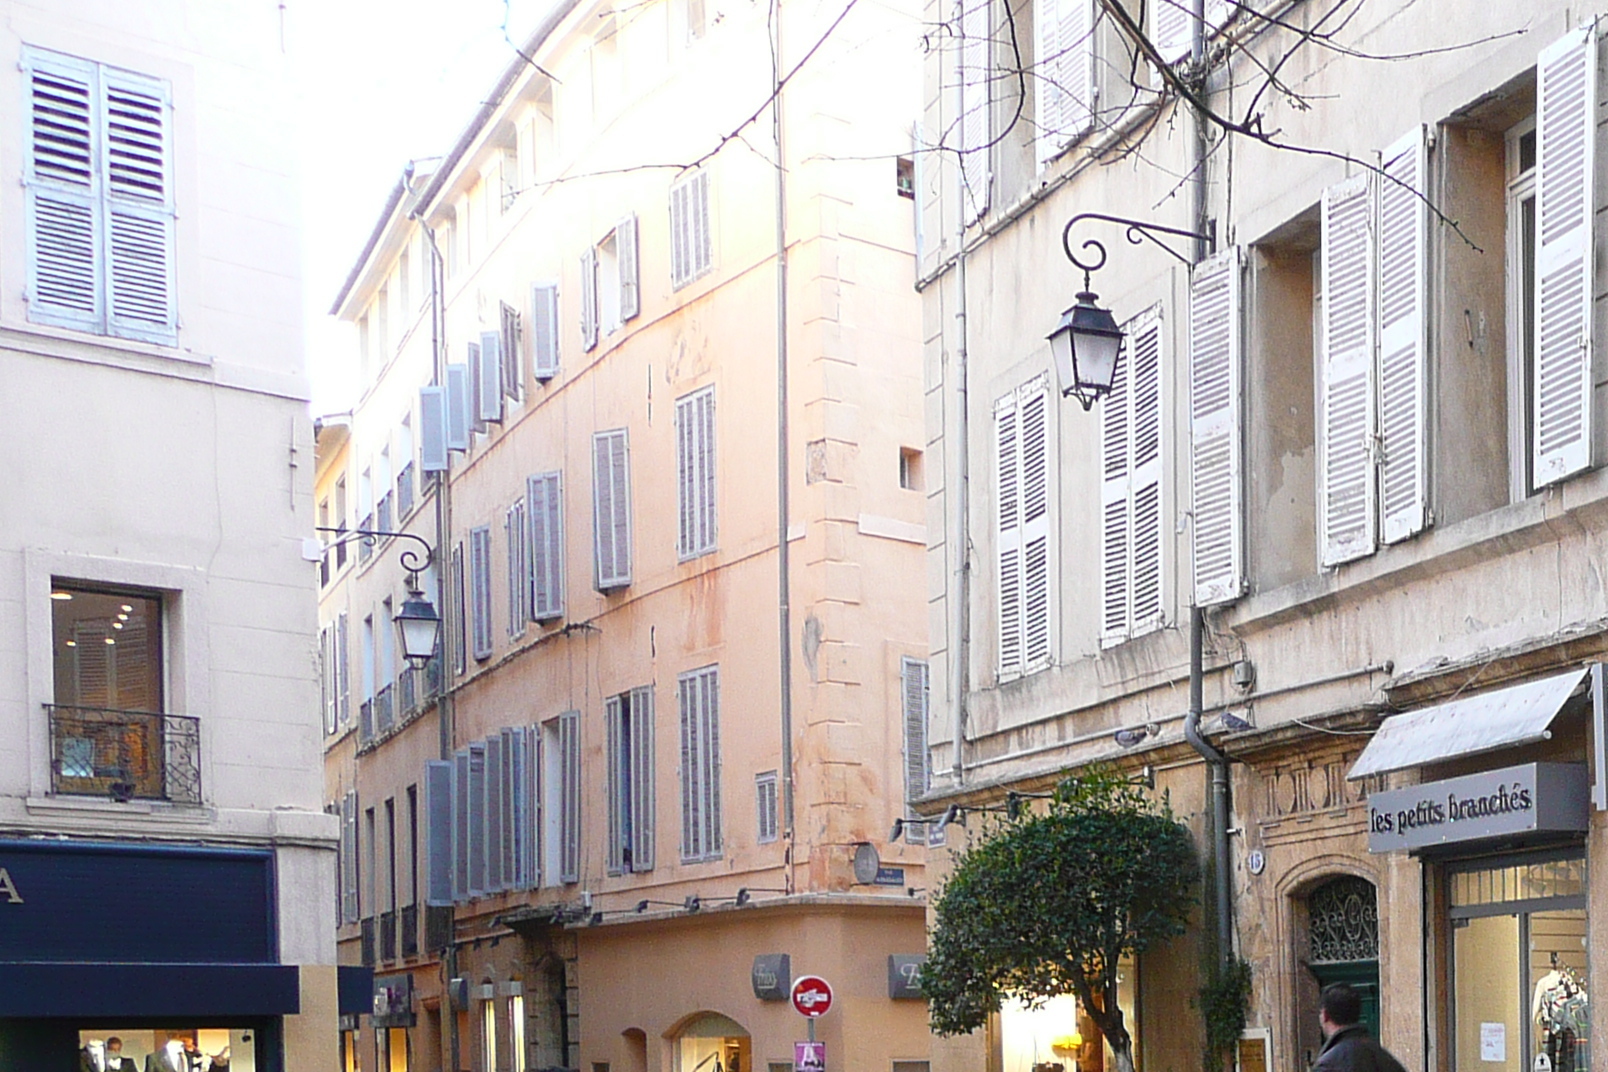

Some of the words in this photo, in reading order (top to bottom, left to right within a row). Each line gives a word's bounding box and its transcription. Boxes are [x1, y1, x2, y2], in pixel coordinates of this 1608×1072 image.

[1370, 807, 1393, 833] les
[1397, 800, 1445, 834] petits
[1448, 782, 1533, 822] branchés
